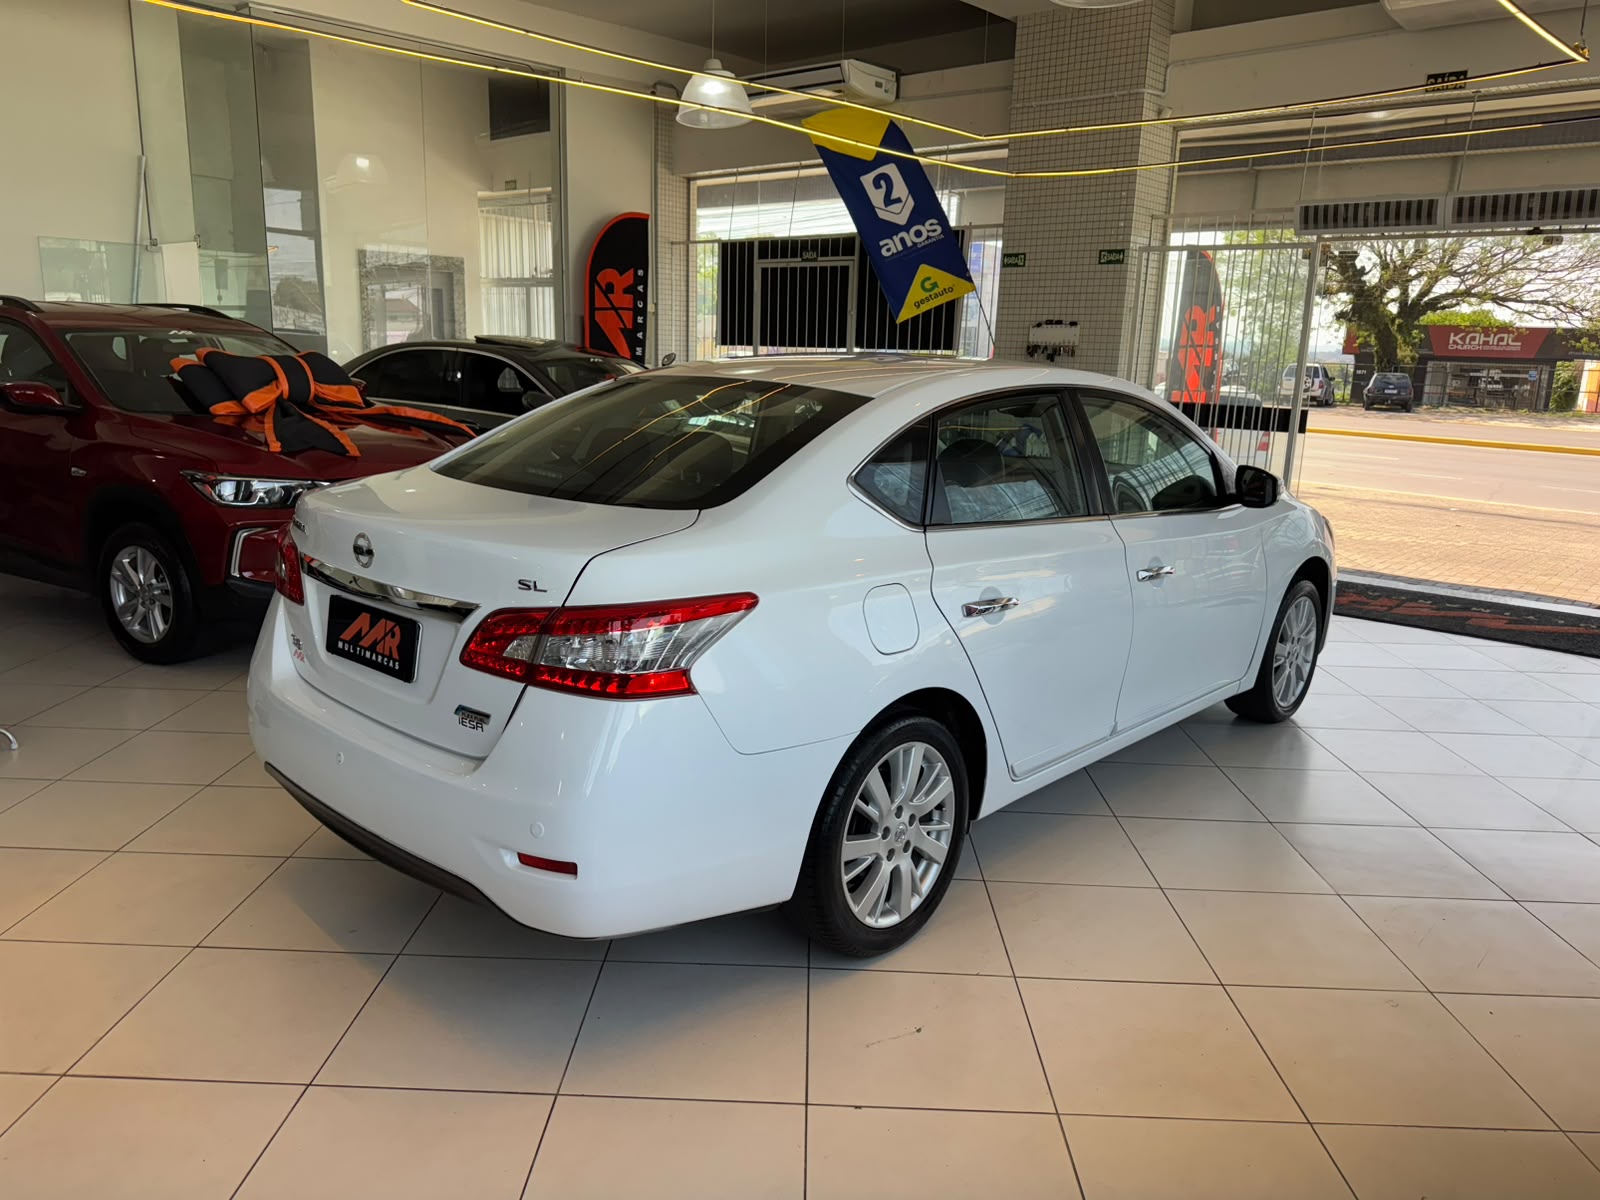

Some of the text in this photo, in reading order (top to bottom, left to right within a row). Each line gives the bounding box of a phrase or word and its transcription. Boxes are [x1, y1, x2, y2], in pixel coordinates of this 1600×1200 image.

[872, 172, 903, 208] 2
[879, 218, 943, 257] anos
[913, 286, 954, 309] gestauto
[1448, 332, 1522, 346] KAHAL
[518, 579, 547, 592] SL
[337, 641, 400, 670] MULTIMARCAS
